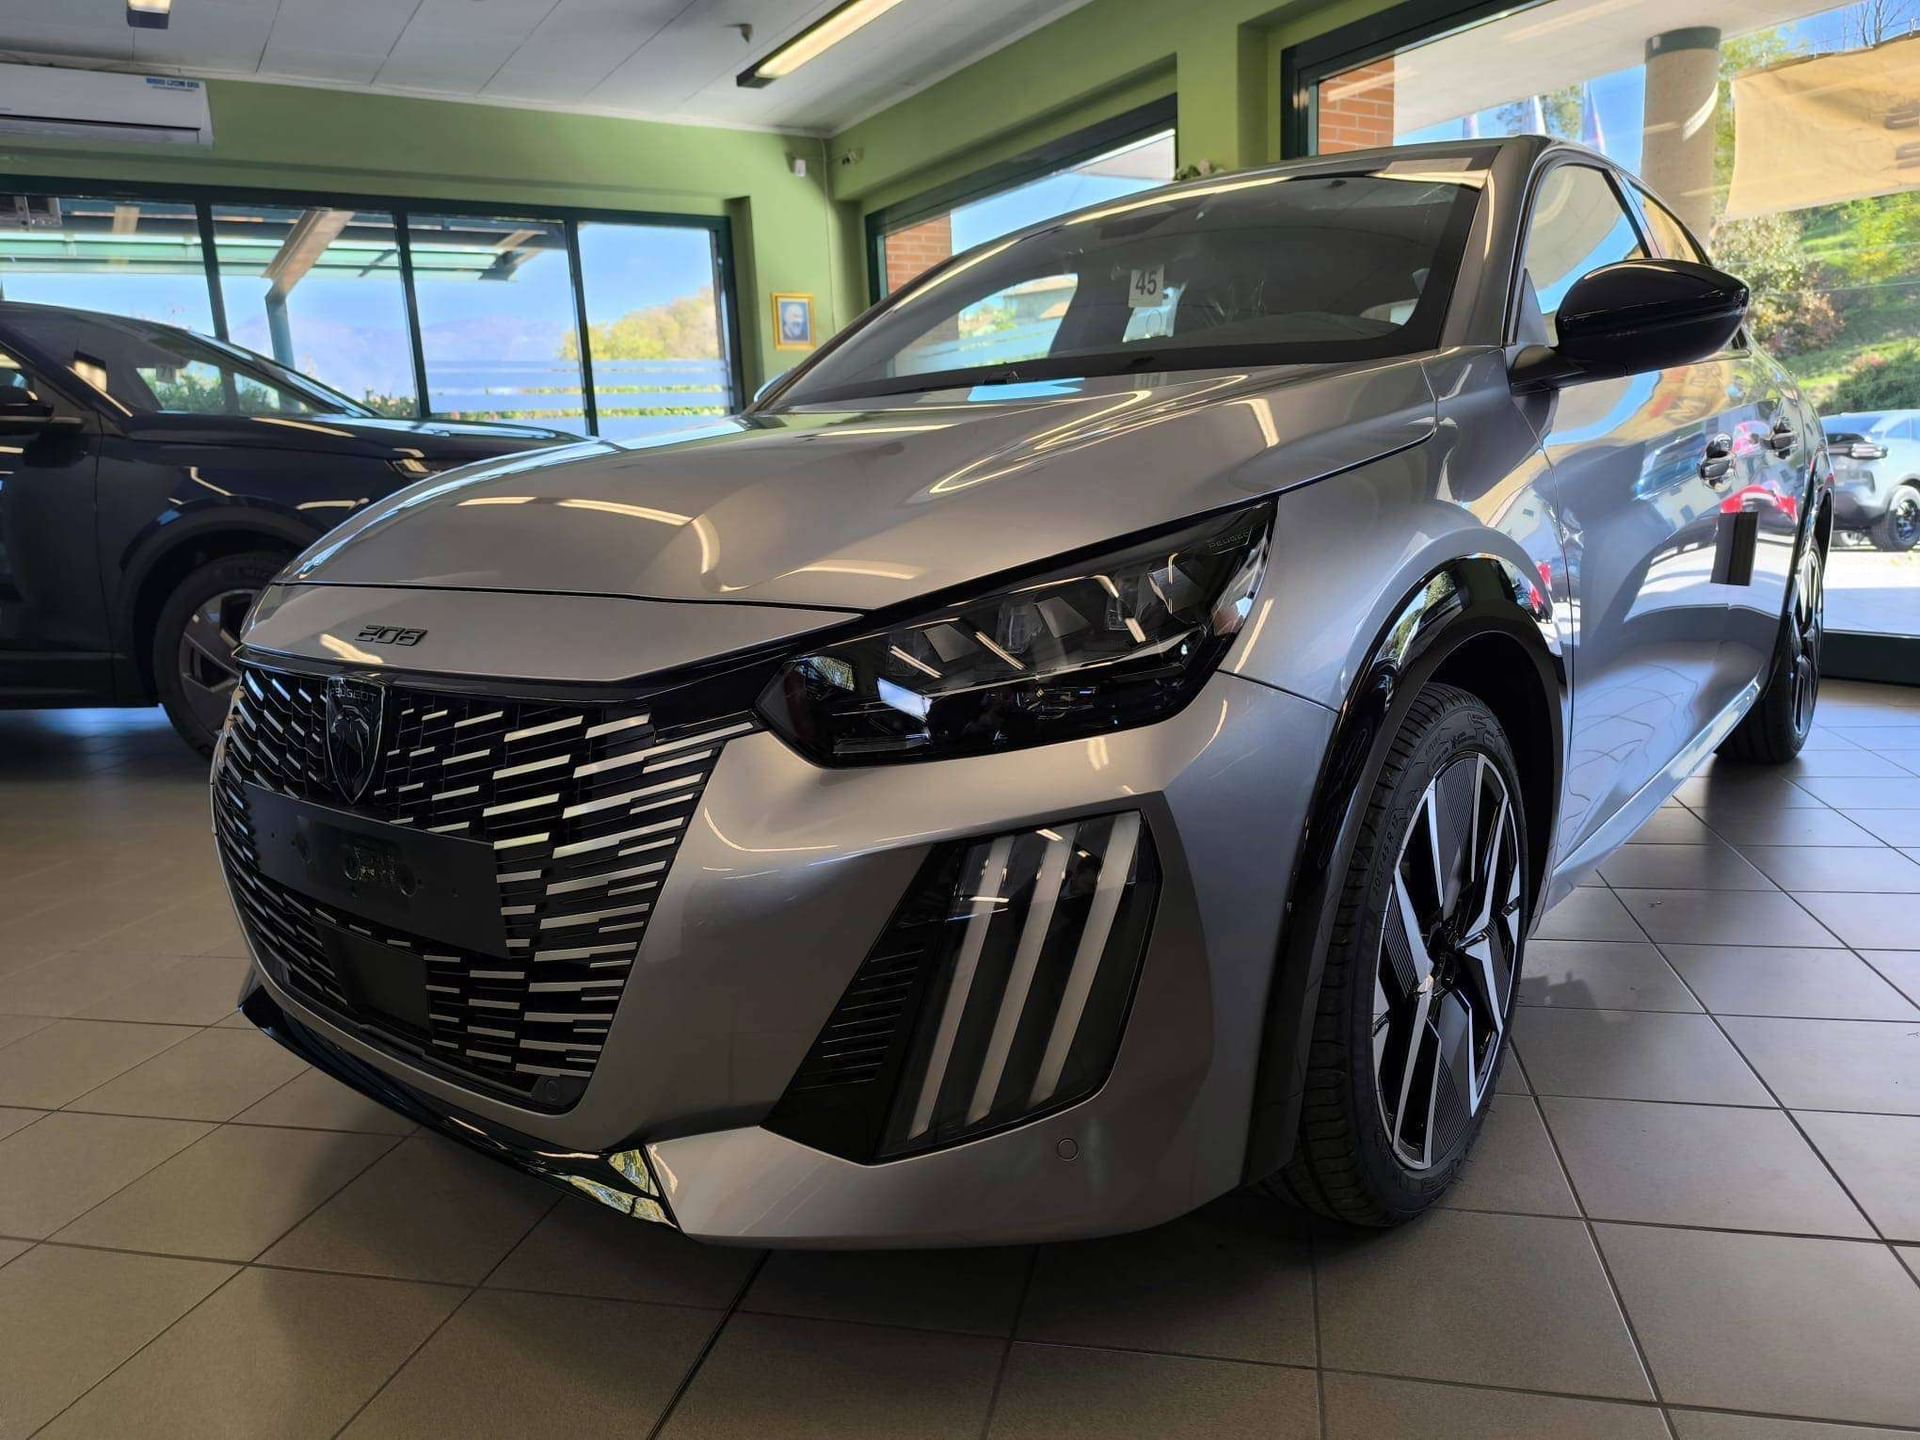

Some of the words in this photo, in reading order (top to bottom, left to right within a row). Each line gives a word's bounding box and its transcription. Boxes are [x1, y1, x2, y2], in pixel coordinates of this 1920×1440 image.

[1136, 271, 1156, 295] 45
[354, 625, 428, 647] 208
[329, 688, 377, 703] PEUGEOT
